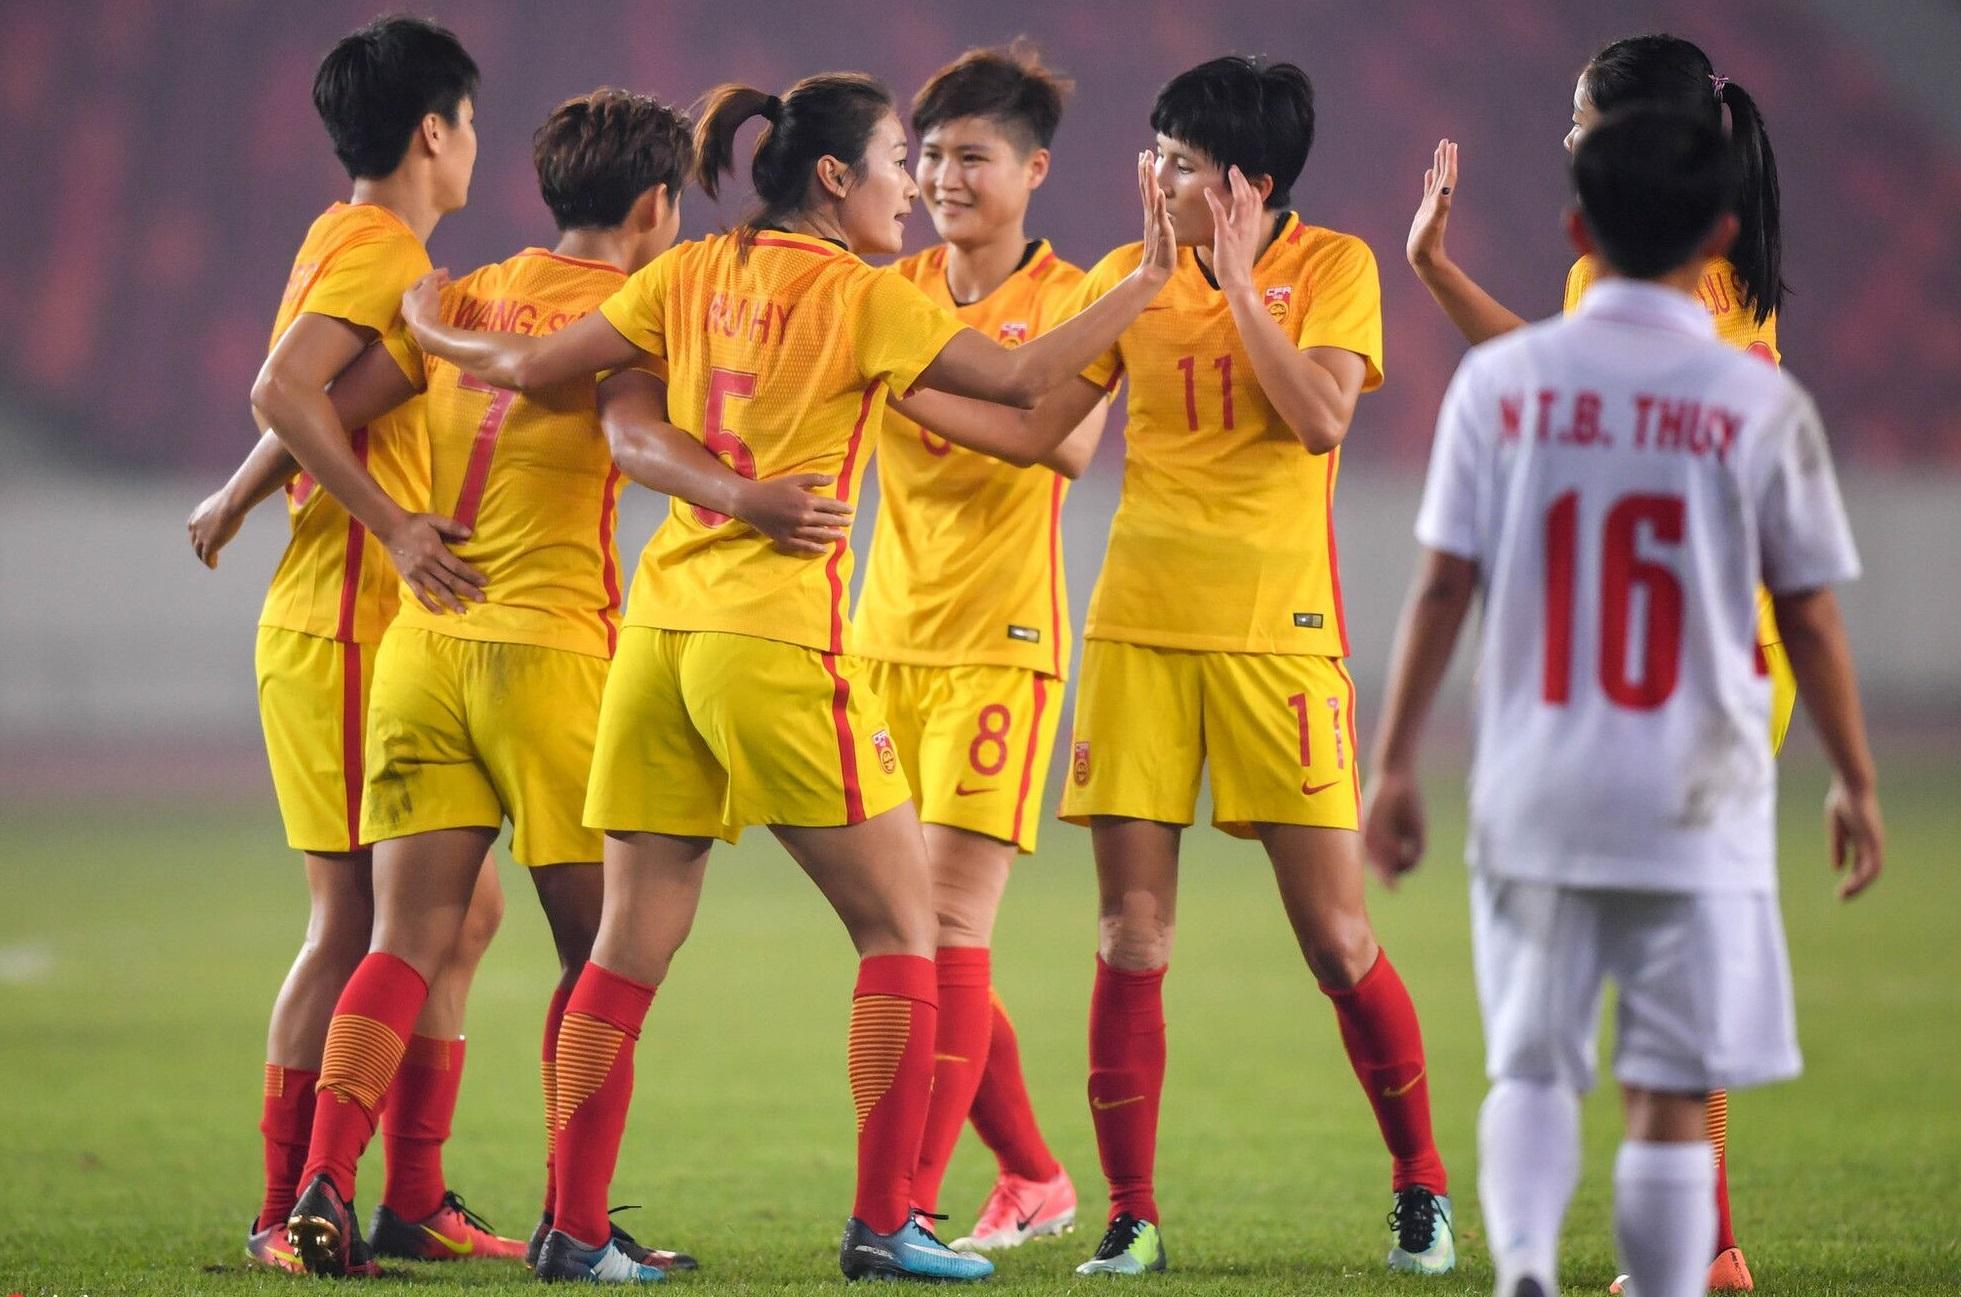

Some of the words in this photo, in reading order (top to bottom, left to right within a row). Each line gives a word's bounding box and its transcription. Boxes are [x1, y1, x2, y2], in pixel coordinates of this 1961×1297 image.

[453, 296, 537, 336] WANG
[1177, 353, 1235, 432] 11
[456, 370, 522, 534] 7
[691, 366, 758, 529] 5
[1542, 486, 1687, 713] 16
[969, 703, 1011, 776] 8
[1287, 692, 1344, 769] 11
